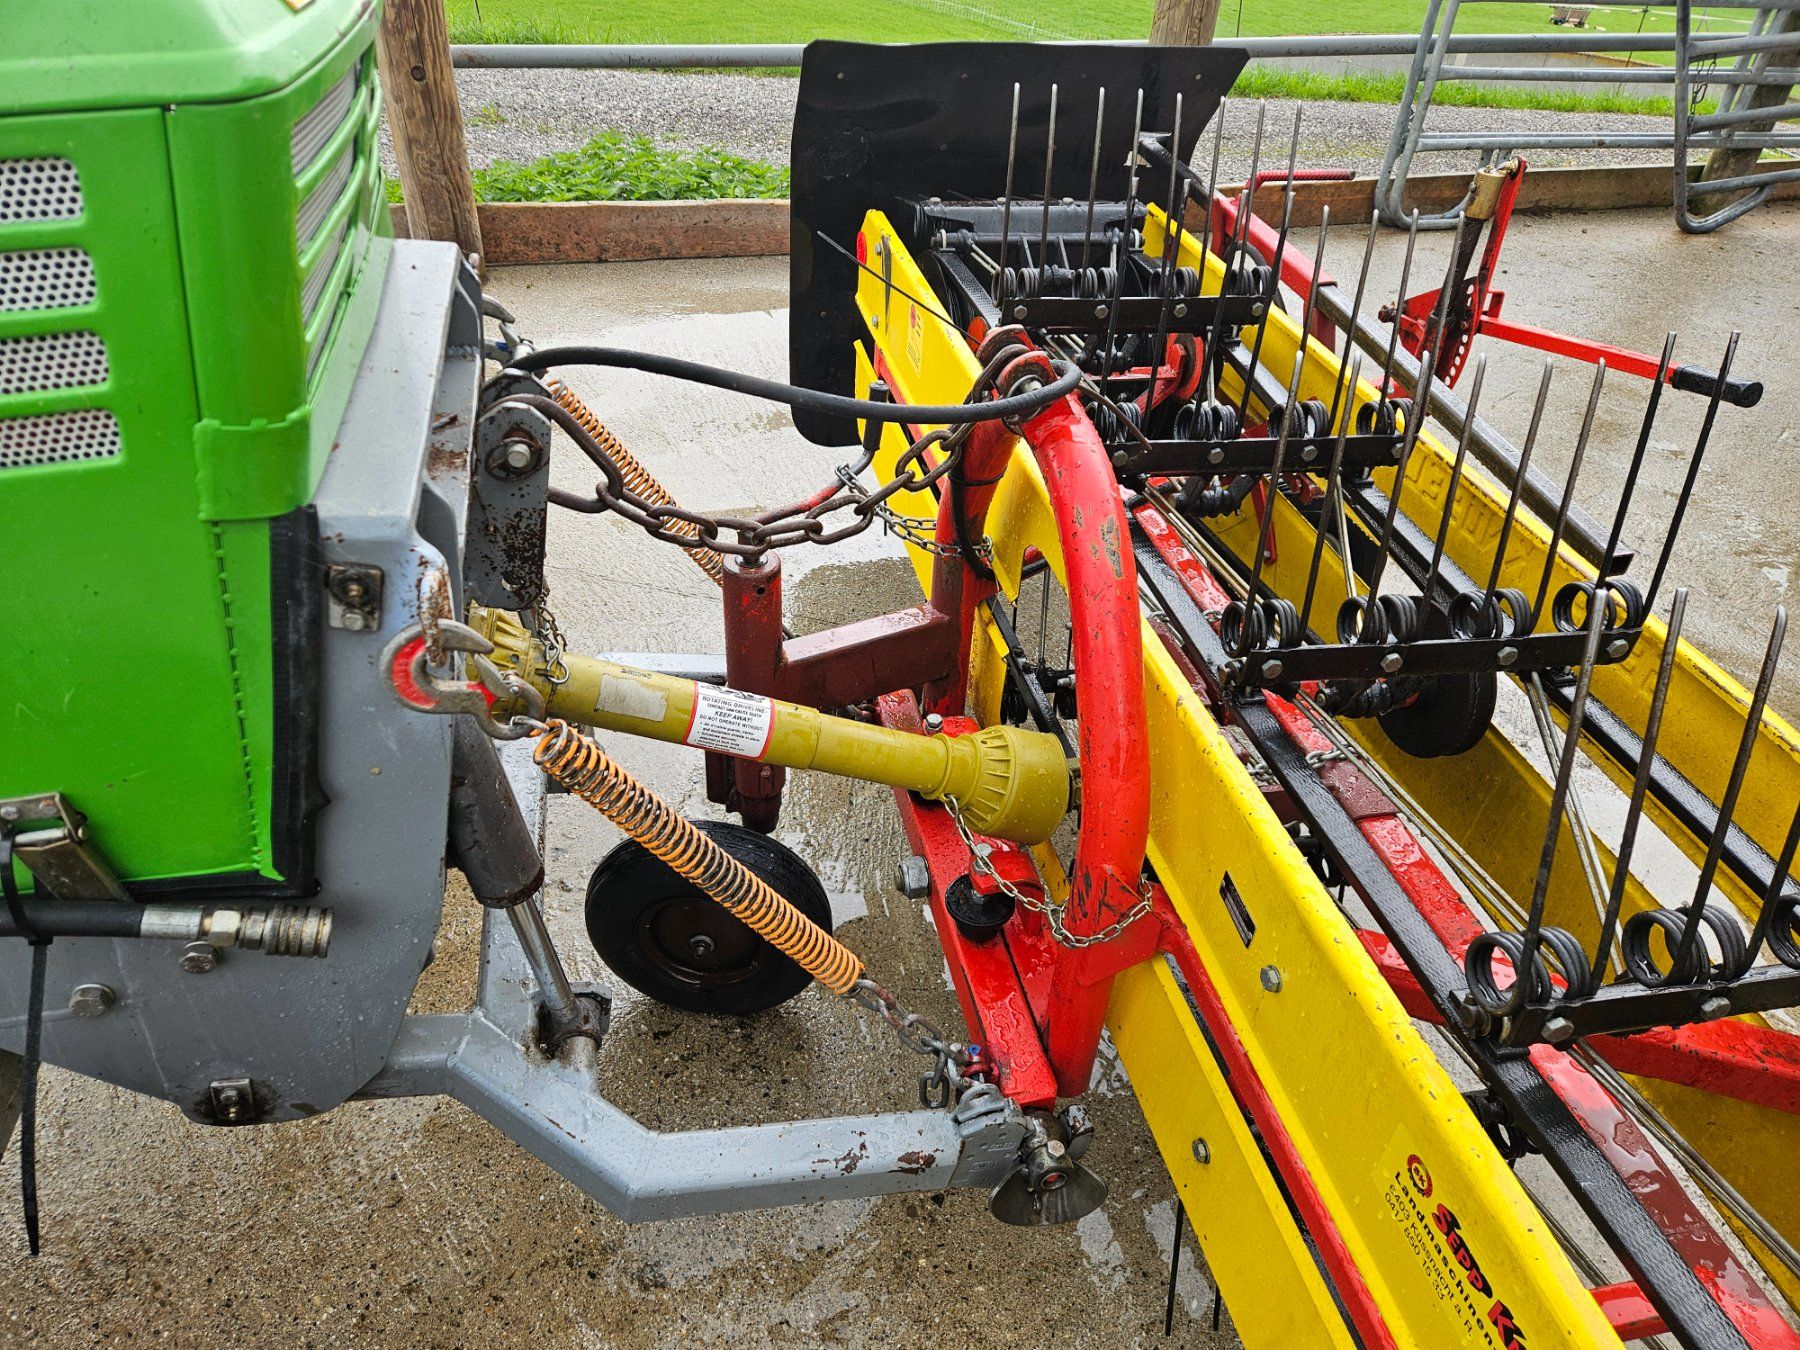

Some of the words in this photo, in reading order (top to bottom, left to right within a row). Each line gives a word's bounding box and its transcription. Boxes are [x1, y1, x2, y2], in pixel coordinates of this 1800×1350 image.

[702, 696, 732, 707] ROTATING
[733, 702, 765, 713] DRIVELINE
[714, 711, 732, 719] KEEP
[732, 714, 753, 723] AWAY!
[718, 718, 741, 727] OPERATE
[1431, 1203, 1493, 1299] SEPP
[1411, 1222, 1454, 1301] Küssnacht
[1422, 1259, 1432, 1277] 15
